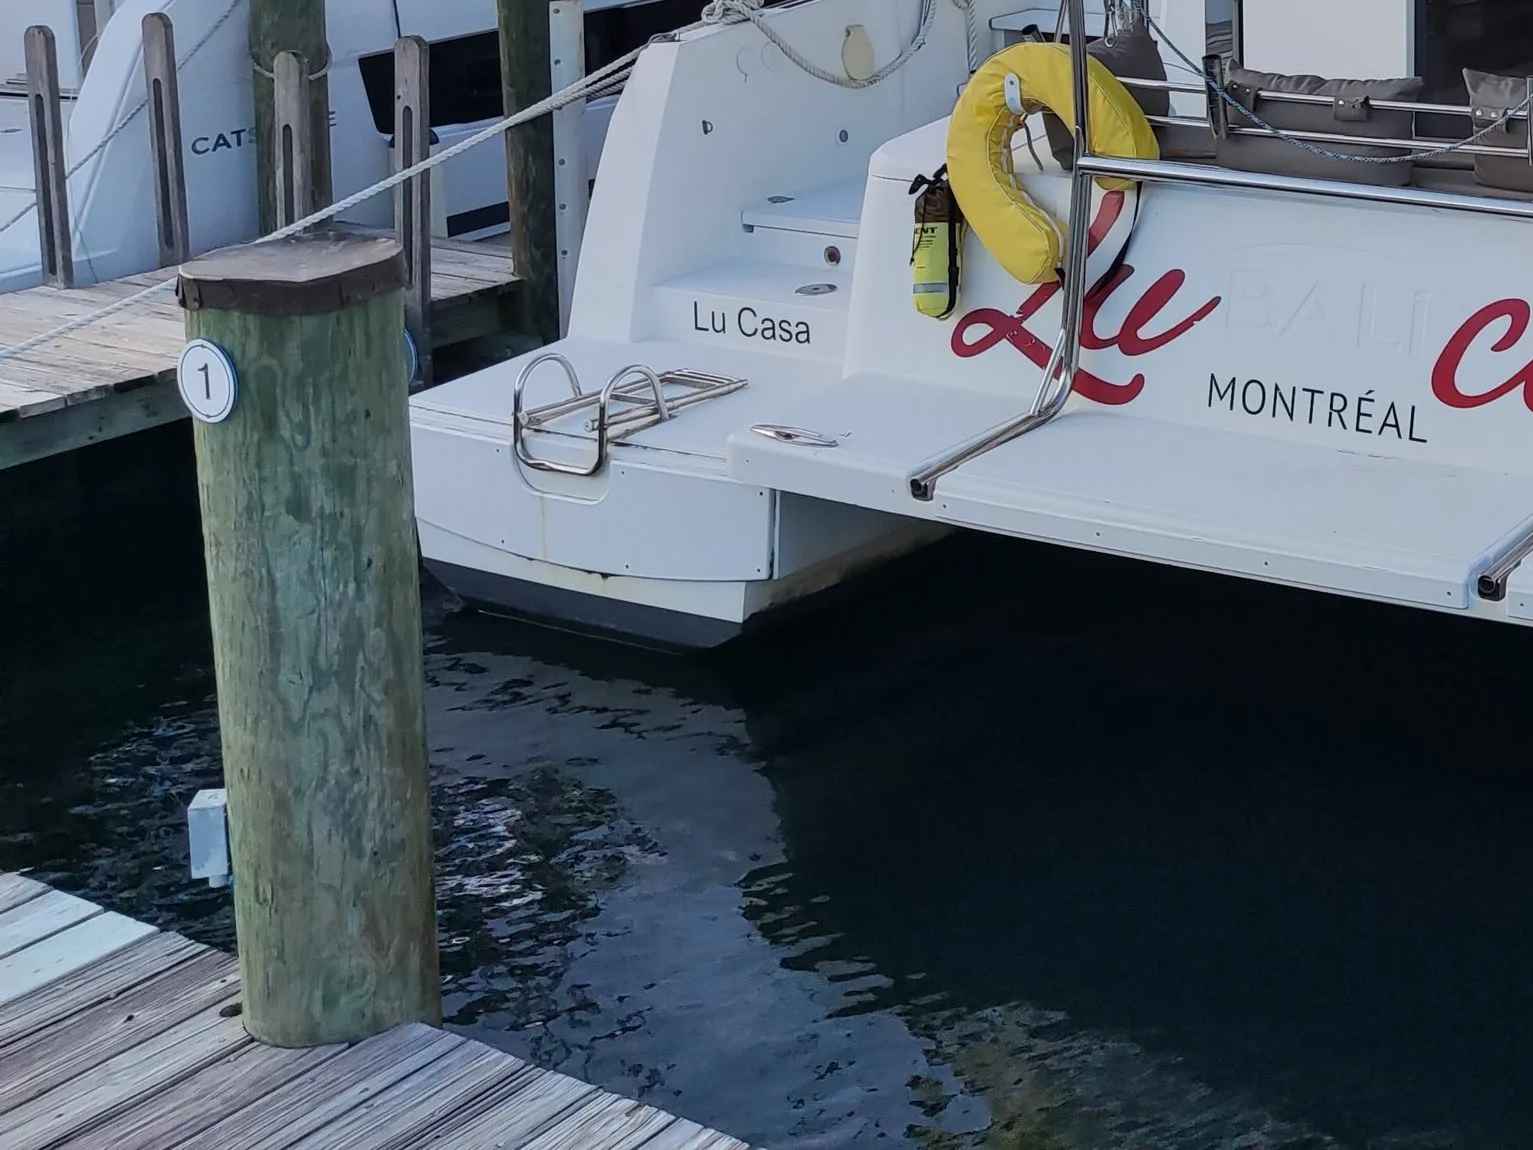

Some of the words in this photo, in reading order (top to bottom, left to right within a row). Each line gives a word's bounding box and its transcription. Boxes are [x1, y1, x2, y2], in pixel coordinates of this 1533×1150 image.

[693, 300, 726, 334] Lu
[737, 306, 811, 344] Casa
[950, 190, 1222, 406] Lu
[197, 362, 211, 400] 1
[1207, 372, 1428, 444] MONTRÉAL
